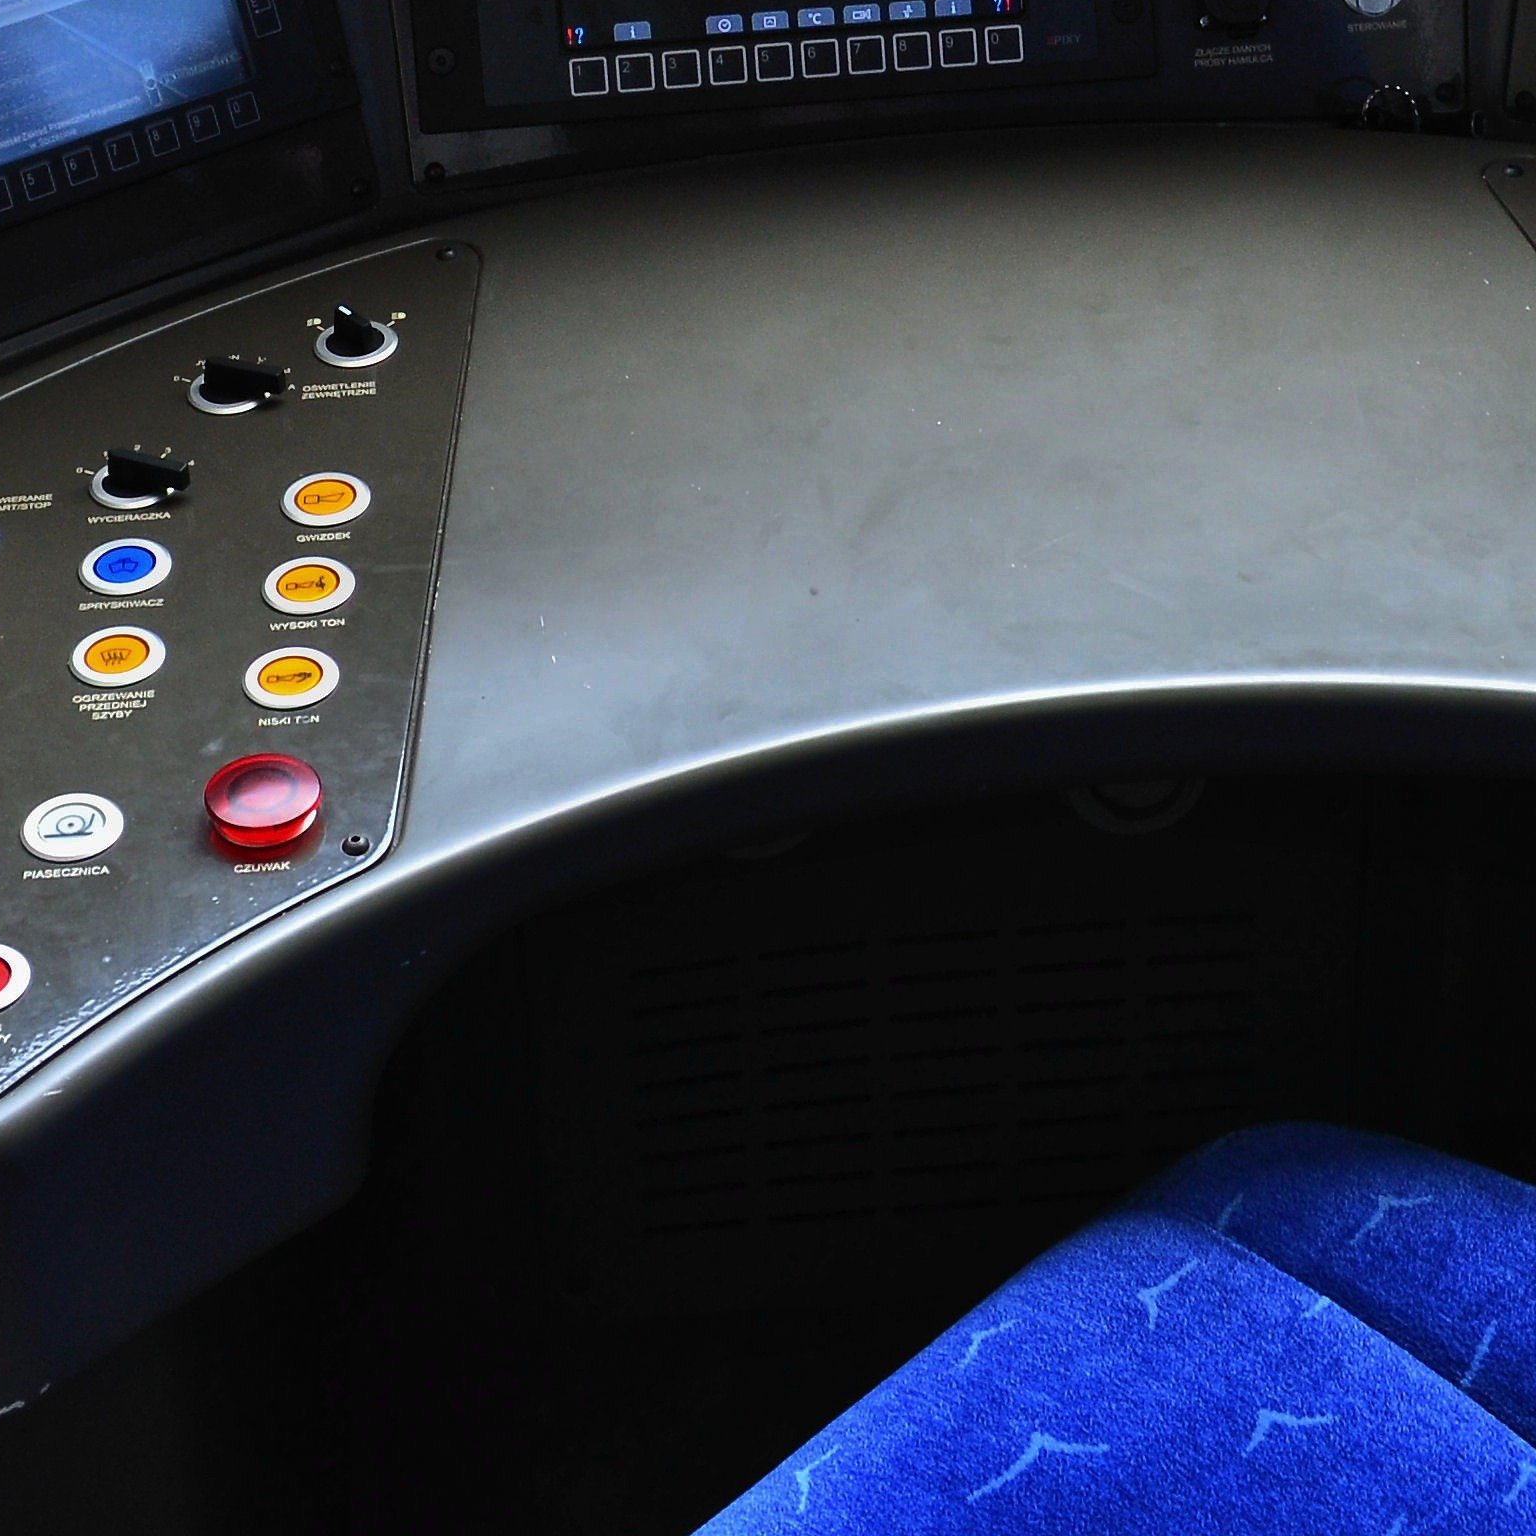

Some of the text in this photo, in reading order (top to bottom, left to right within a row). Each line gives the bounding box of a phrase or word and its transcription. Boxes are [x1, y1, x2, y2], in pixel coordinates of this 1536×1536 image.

[301, 387, 377, 400] ZEWNĘTRZNE
[87, 512, 171, 524] WYCIERACZKA
[296, 531, 351, 543] GWIZDEK
[78, 598, 165, 611] SPRYSKIWACZ
[269, 618, 345, 631] WYSOKI TON
[72, 690, 155, 703] OGRZEWANIE
[78, 699, 147, 712] PRZEDNIEJ
[91, 710, 133, 720] SZYBY
[258, 715, 292, 727] NISKI
[23, 865, 110, 880] PIASECZNICA
[233, 861, 291, 874] CZUWAK
